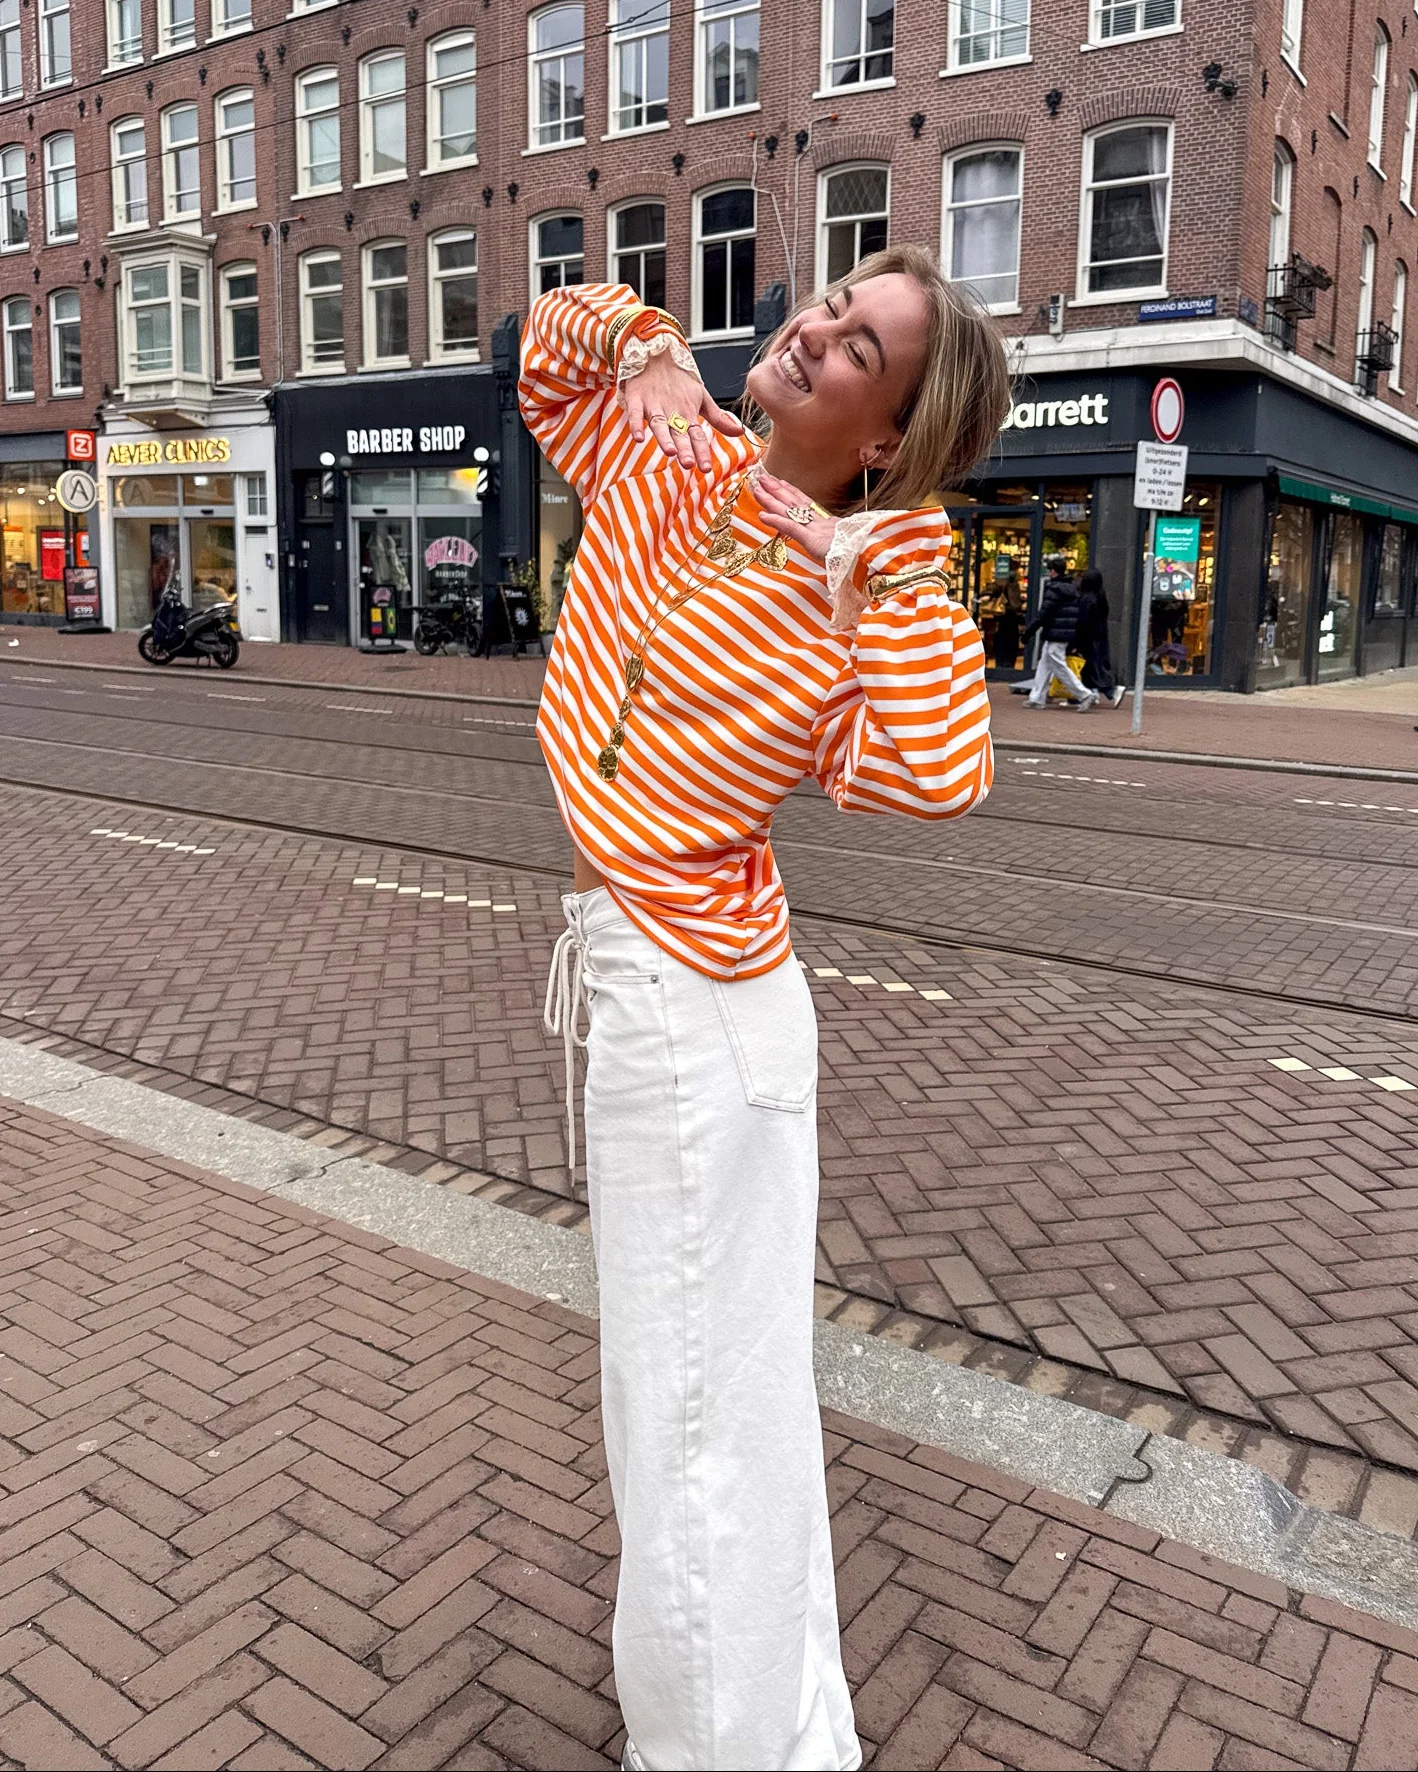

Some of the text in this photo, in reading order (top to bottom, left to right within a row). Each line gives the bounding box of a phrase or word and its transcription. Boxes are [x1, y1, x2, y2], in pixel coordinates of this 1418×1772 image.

[1140, 299, 1213, 313] FERDINAND BOLSTRAAT
[107, 436, 232, 466] AEVER CLINICS
[346, 425, 466, 454] BARBER SHOP
